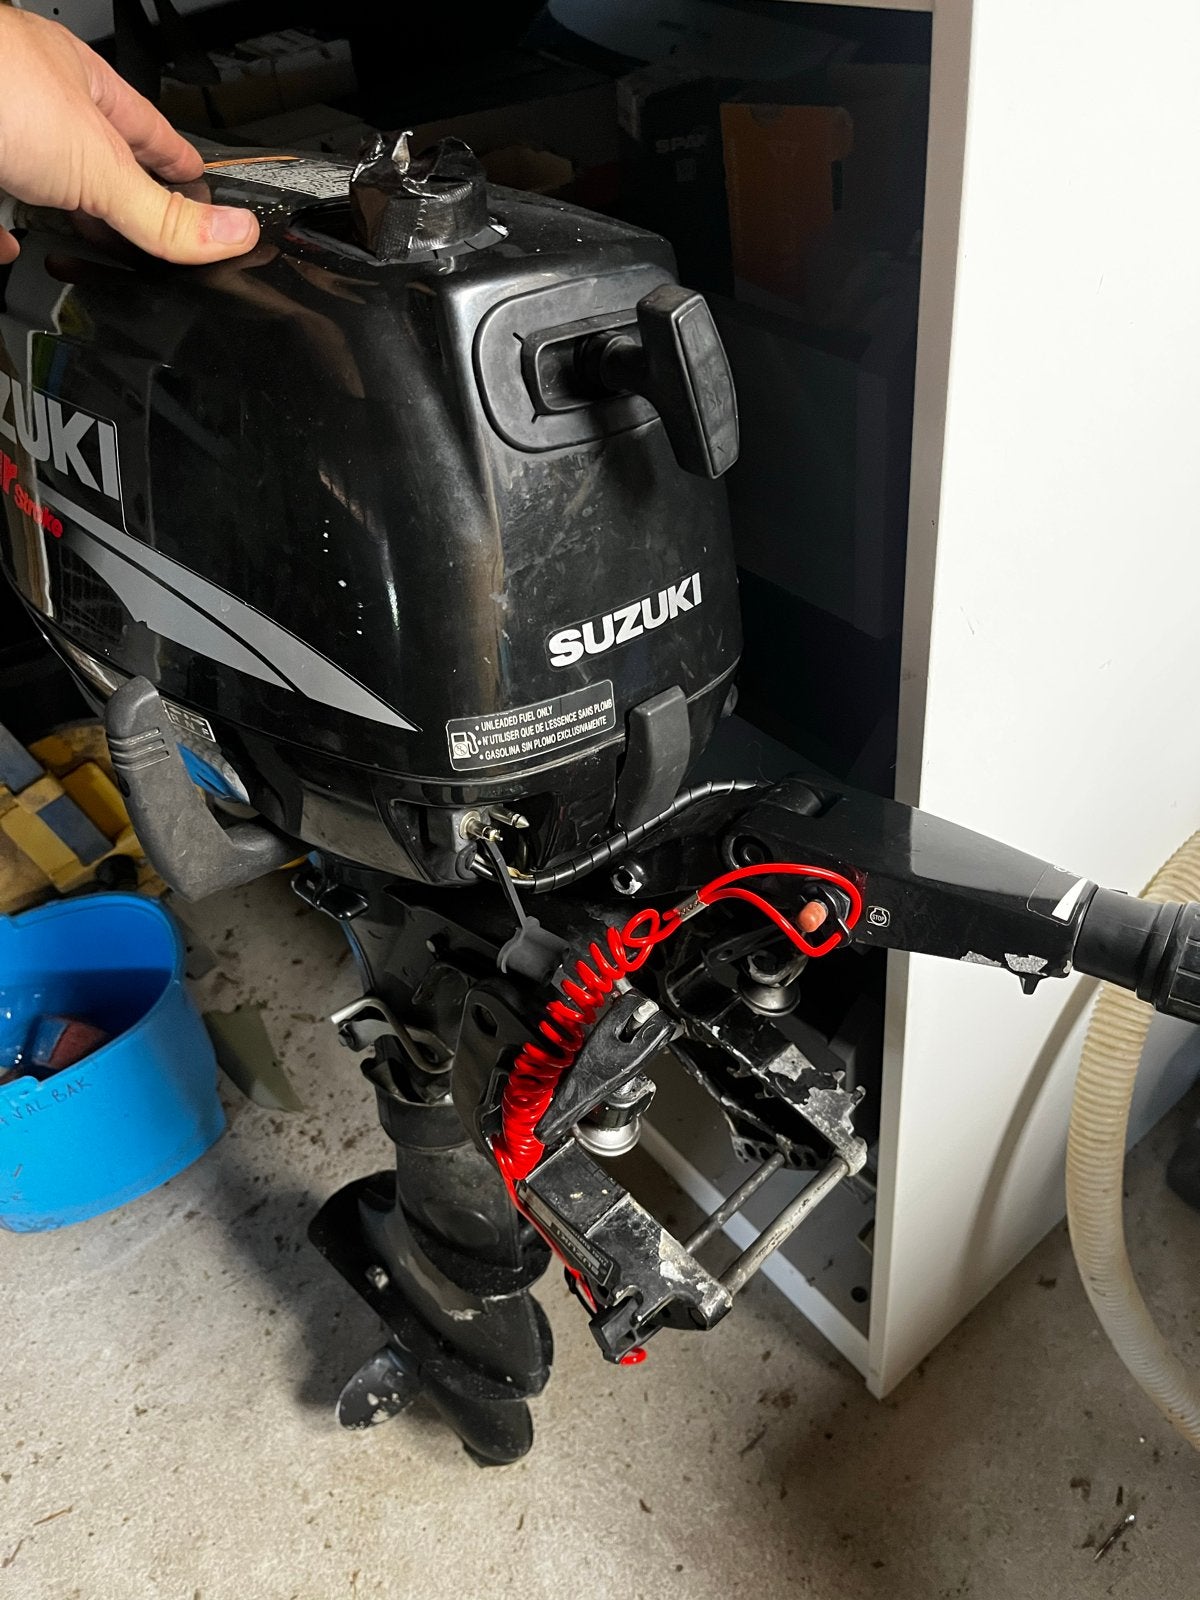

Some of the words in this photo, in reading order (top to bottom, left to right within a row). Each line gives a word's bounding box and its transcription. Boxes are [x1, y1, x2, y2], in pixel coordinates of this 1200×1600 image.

[14, 483, 63, 538] Stroke
[548, 572, 702, 667] SUZUKI
[481, 715, 518, 731] UNLEADED
[519, 711, 535, 723] FUEL
[536, 705, 553, 719] ONLY
[485, 744, 520, 760] GASOLINA
[521, 740, 533, 752] SIN
[533, 733, 556, 749] PLOMO
[556, 715, 607, 742] EXCLUSIVAMENTE
[520, 725, 535, 738] QUE
[535, 722, 545, 734] DE
[545, 711, 578, 731] L'ESSENCE
[578, 706, 594, 720] SANS
[593, 698, 613, 714] PLOMB
[872, 913, 885, 922] STOP
